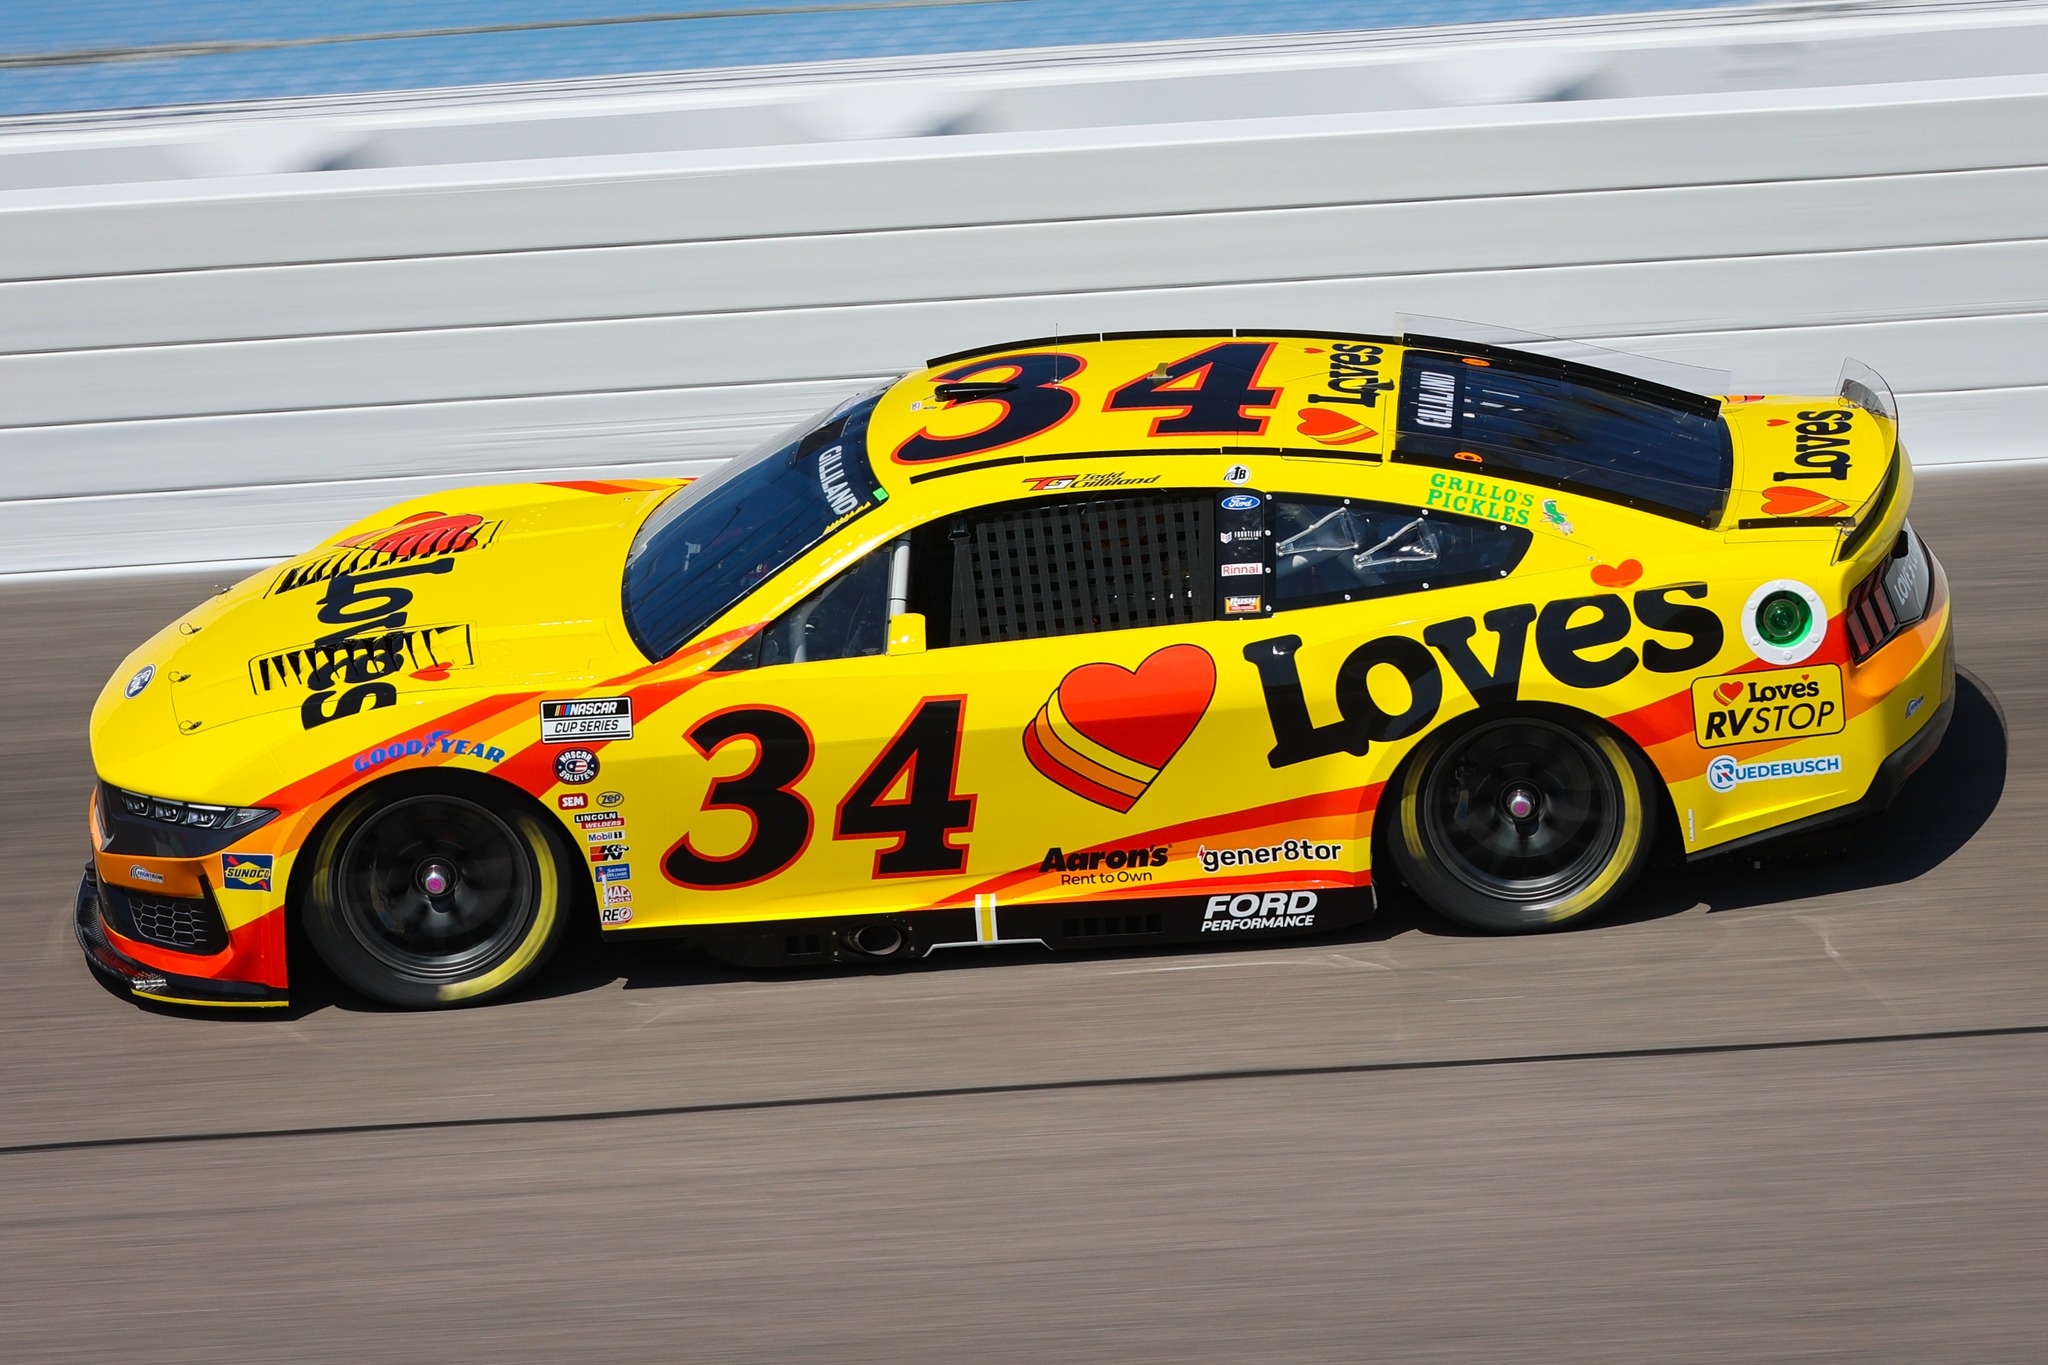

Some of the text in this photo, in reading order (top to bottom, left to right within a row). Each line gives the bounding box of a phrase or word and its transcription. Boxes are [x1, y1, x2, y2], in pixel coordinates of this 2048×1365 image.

[890, 342, 1283, 465] 34
[1416, 371, 1456, 429] GILLILAND
[819, 445, 859, 515] GILLILAND
[1070, 475, 1162, 488] Gilliland
[1083, 471, 1126, 481] Todd
[1431, 473, 1535, 507] GRILLO'S
[1227, 496, 1254, 509] Ford
[1425, 488, 1530, 525] PICKLES
[1223, 564, 1259, 574] Rinnai
[128, 668, 152, 695] Ford
[570, 701, 618, 715] NASCAR
[554, 719, 620, 733] CUP SERIES
[559, 750, 593, 763] NASCAR
[559, 769, 595, 781] SALUTES
[1711, 758, 1839, 786] RUEDEBUSCH
[659, 694, 978, 891] 34
[561, 796, 585, 807] SEM
[575, 812, 616, 822] LINCOLN
[585, 820, 622, 829] WELDERS
[588, 832, 613, 841] Mobil
[1039, 844, 1169, 873] Aaron's
[1202, 839, 1342, 873] gener8tor
[226, 867, 270, 880] SUNOCO
[1061, 870, 1153, 886] Rent to Own
[606, 896, 631, 904] OOLS
[1203, 891, 1318, 920] FORD
[1201, 914, 1316, 933] PERFORMANCE
